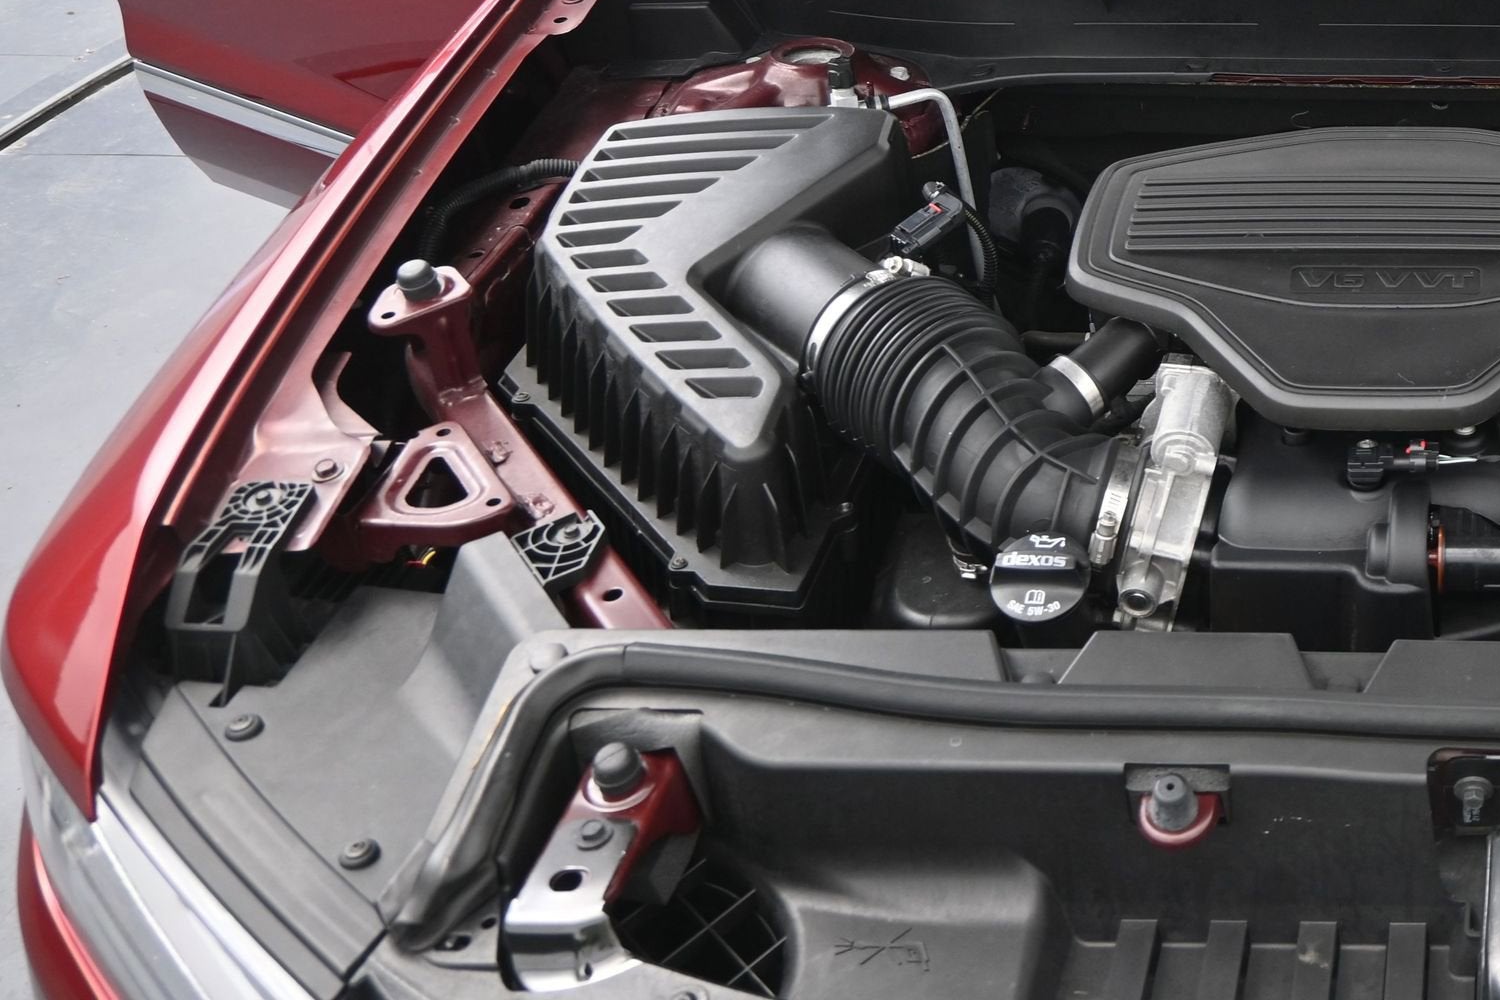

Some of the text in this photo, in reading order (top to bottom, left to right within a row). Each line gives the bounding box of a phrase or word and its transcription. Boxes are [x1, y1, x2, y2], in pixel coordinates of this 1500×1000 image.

[1299, 271, 1474, 288] V6 VVT
[1002, 551, 1068, 567] dexos
[1007, 599, 1061, 616] SAE 5W-30
